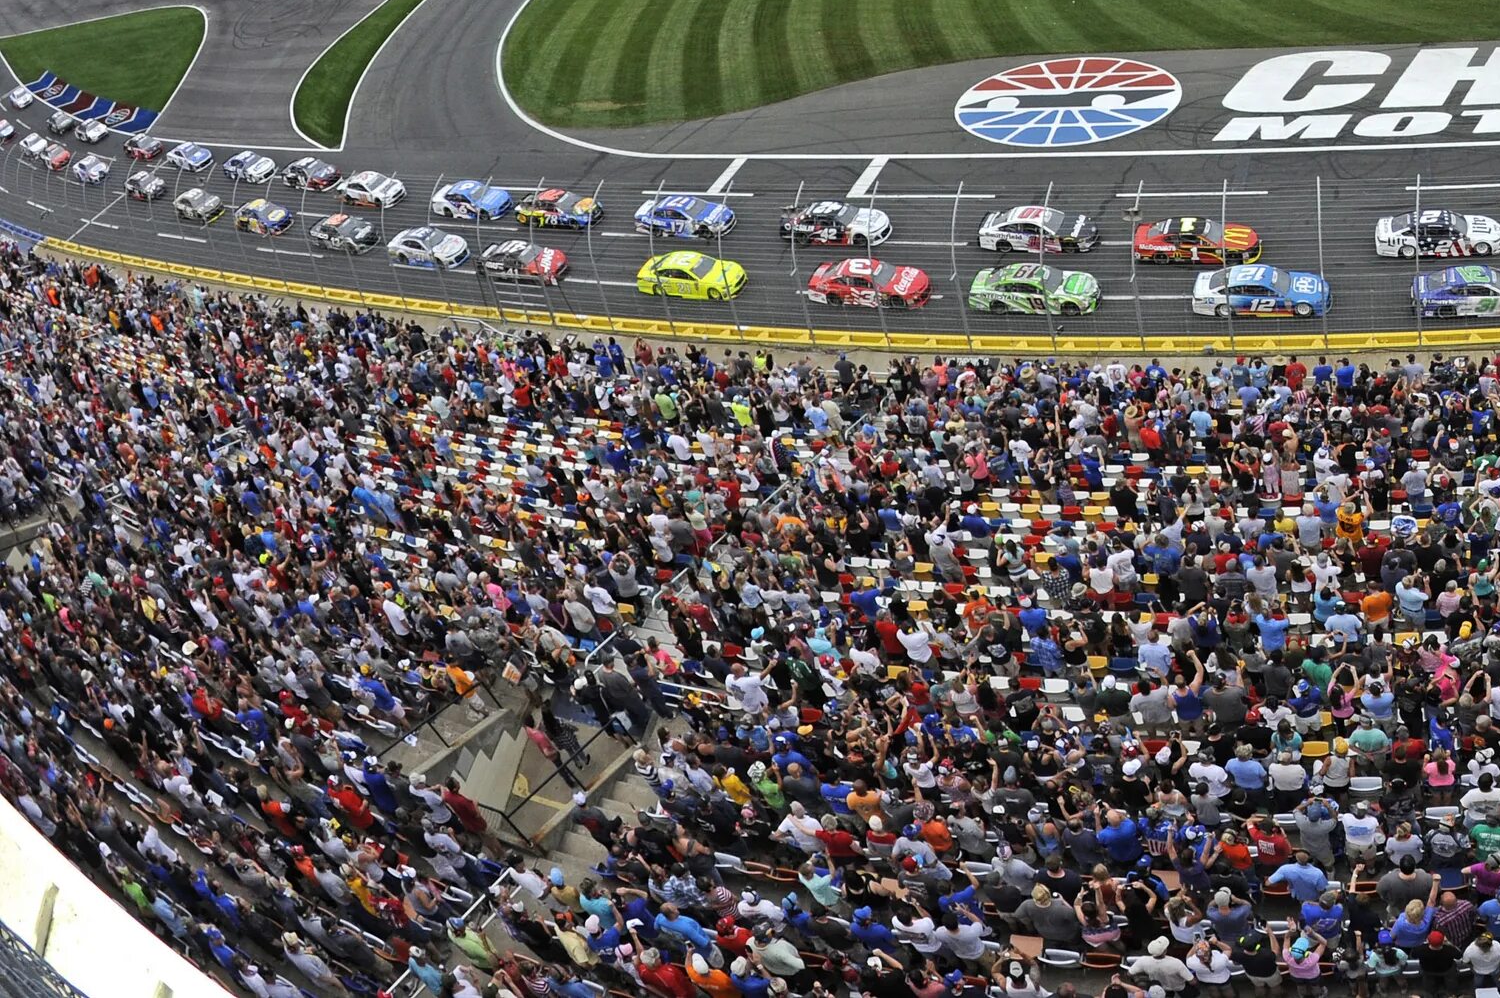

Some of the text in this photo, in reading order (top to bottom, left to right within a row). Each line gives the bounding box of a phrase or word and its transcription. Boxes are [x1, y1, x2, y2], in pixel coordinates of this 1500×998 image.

[459, 204, 467, 214] 6
[544, 214, 558, 225] 78
[1420, 209, 1442, 224] 2
[671, 220, 686, 233] 17
[820, 228, 837, 243] 42
[1139, 243, 1177, 252] McDonald's
[1435, 239, 1451, 253] 2
[1190, 247, 1200, 261] 1
[848, 258, 872, 275] 3
[1236, 267, 1266, 281] 12
[1455, 265, 1491, 283] 31
[859, 290, 877, 303] 3
[1027, 297, 1046, 310] 19
[1250, 298, 1276, 312] 12
[1475, 298, 1499, 312] 31
